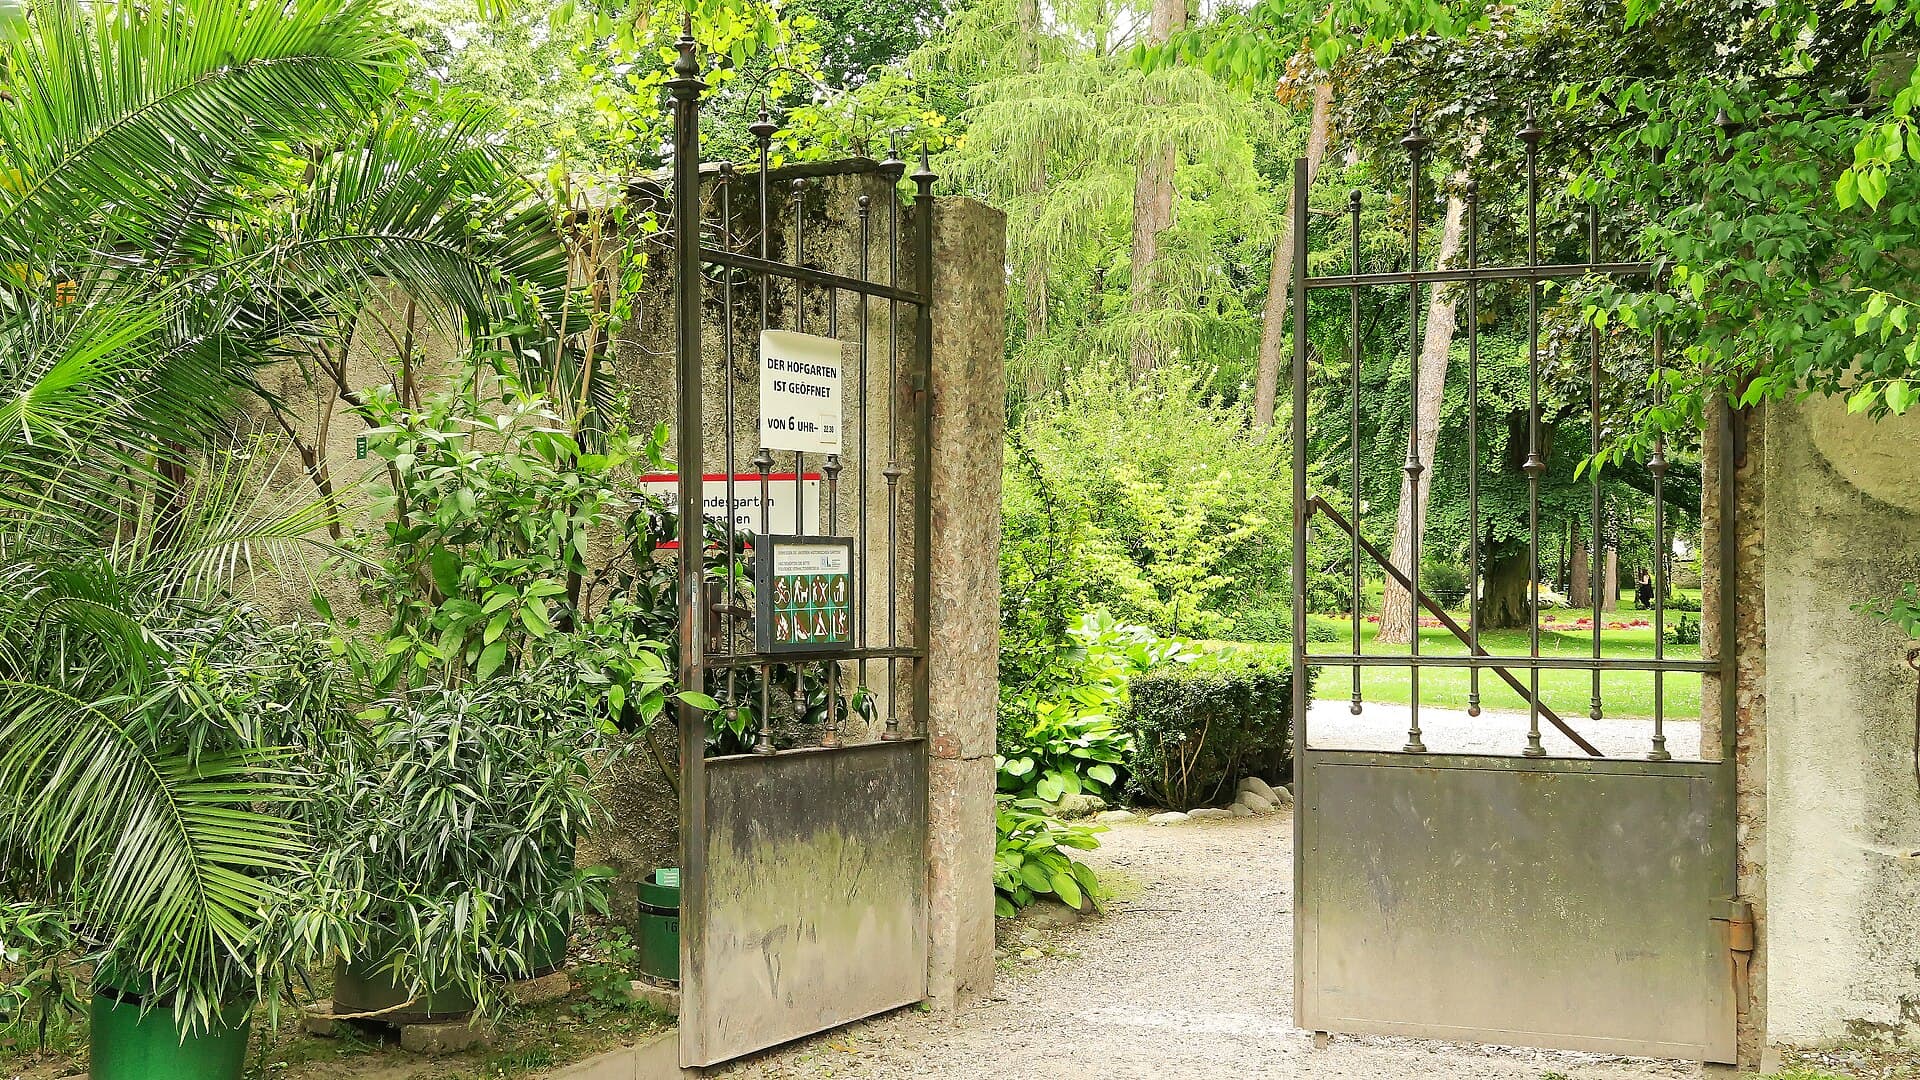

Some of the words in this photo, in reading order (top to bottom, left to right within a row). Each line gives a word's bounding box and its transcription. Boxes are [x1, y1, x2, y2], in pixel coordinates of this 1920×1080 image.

[767, 357, 785, 371] DER
[787, 360, 837, 379] HOFGARTEN
[773, 379, 787, 392] IST
[788, 381, 831, 398] GEÖFFNET
[767, 417, 786, 430] VON
[788, 416, 795, 431] 6
[703, 495, 774, 510] ndegartn
